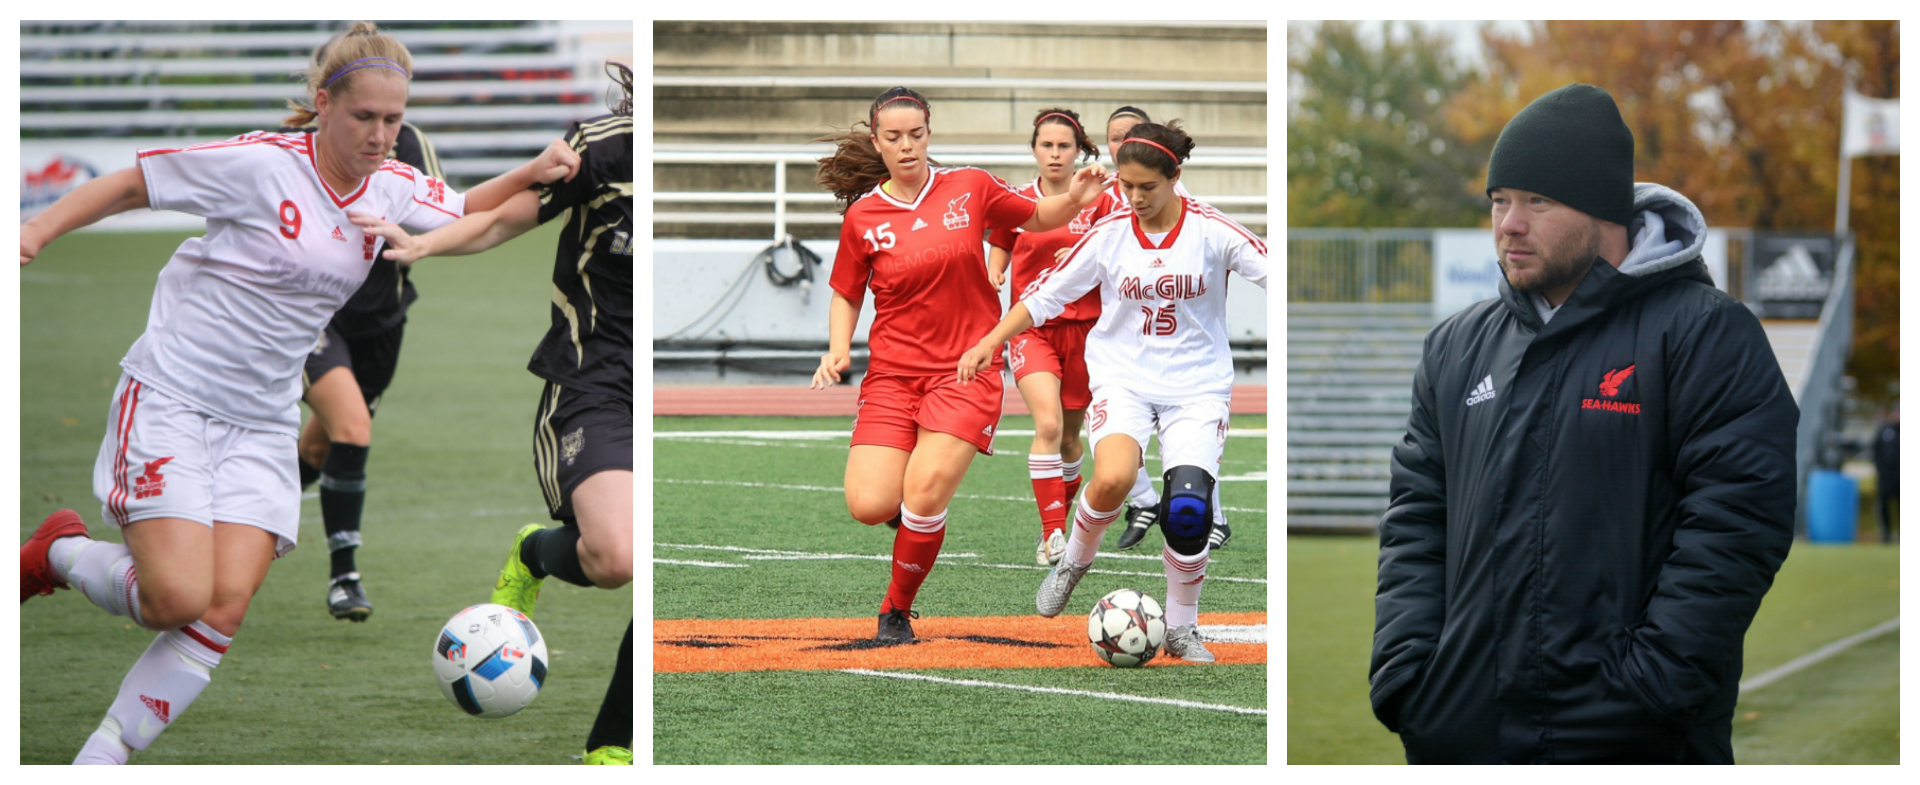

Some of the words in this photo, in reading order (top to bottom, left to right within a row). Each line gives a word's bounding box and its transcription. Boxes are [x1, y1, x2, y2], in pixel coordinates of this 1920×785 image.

[279, 199, 302, 240] 9
[863, 222, 896, 251] 15
[1141, 304, 1178, 336] 15
[1466, 390, 1496, 406] adidas
[1581, 398, 1641, 414] SEA-HAWKS
